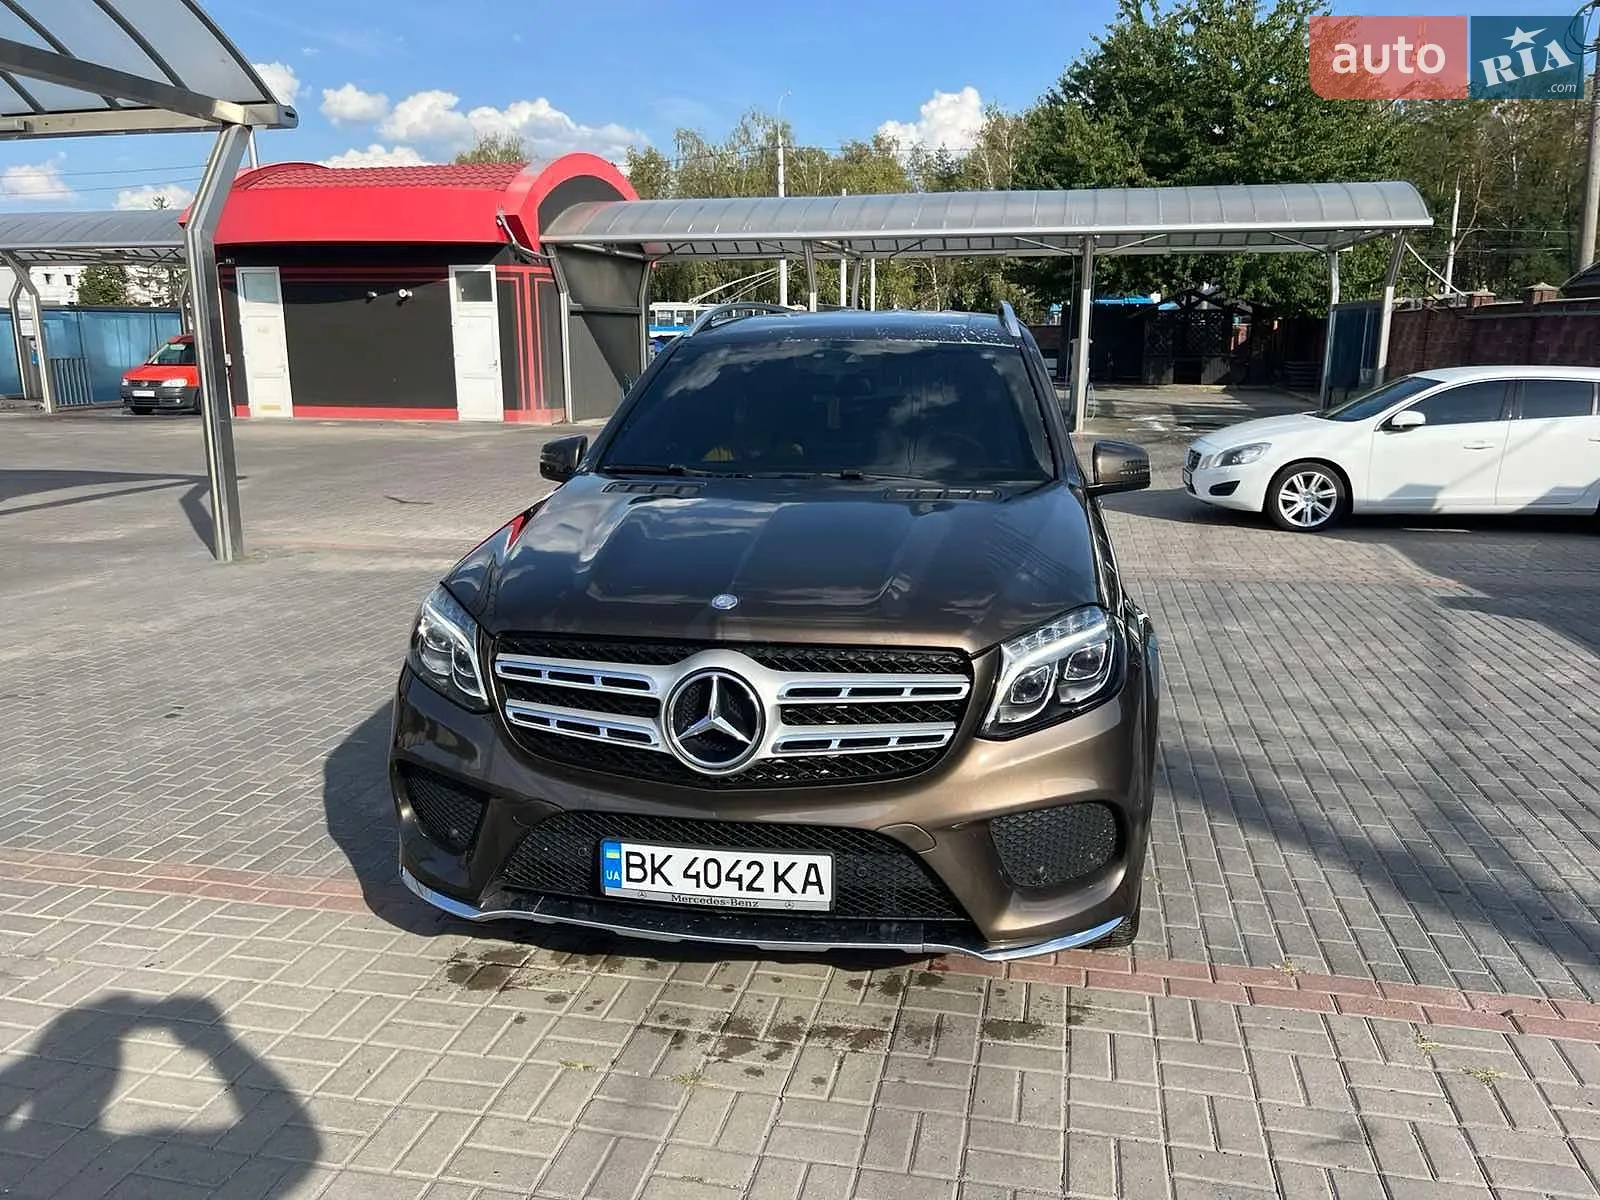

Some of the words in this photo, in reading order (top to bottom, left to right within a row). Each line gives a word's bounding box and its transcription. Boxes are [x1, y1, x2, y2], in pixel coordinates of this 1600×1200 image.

[605, 870, 620, 881] UA
[625, 851, 673, 886] BK
[682, 856, 765, 892] 4042
[773, 861, 825, 895] KA
[671, 894, 760, 908] Mercedes-Benz
